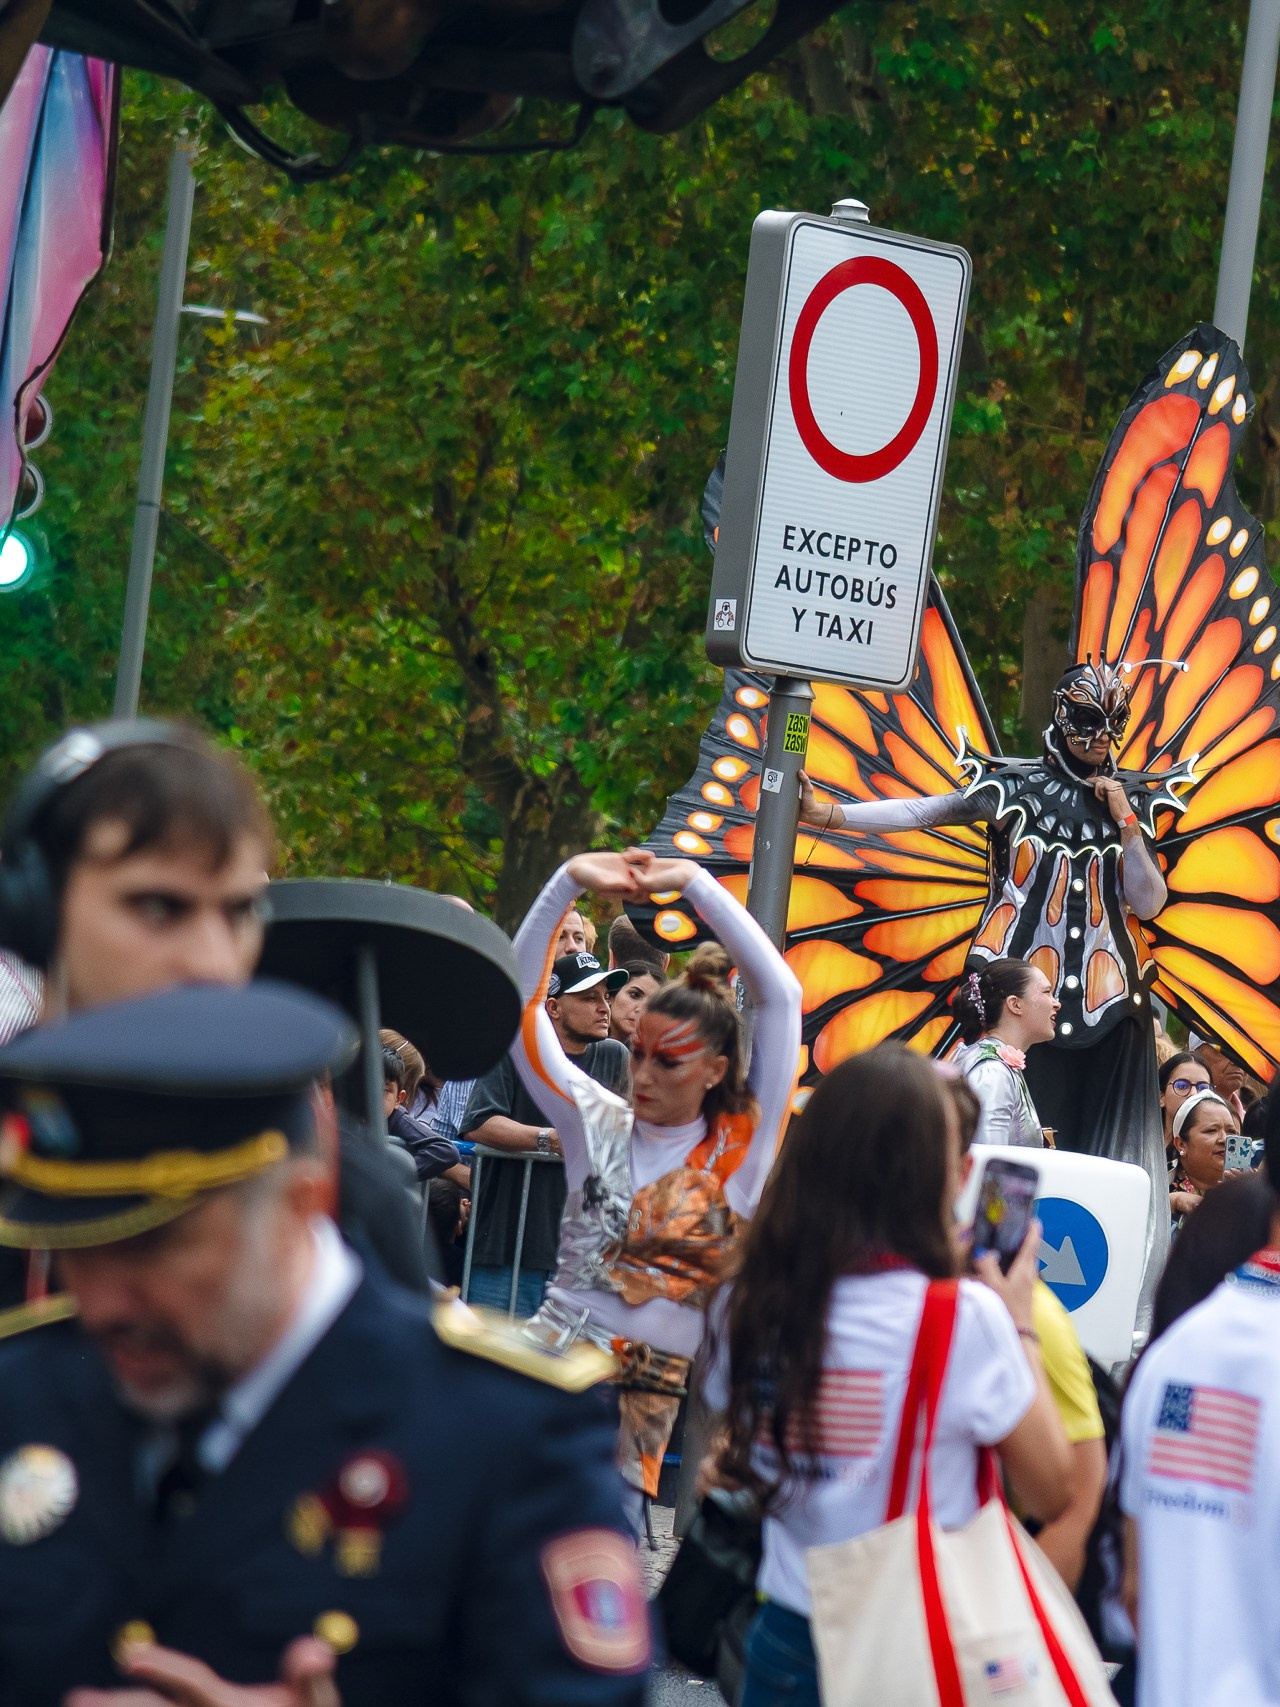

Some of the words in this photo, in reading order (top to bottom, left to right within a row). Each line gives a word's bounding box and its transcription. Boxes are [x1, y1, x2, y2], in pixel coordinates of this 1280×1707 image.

[783, 525, 897, 569] EXCEPTO
[774, 565, 897, 609] AUTOBÚS
[792, 607, 807, 632] Y
[815, 611, 873, 645] TAXI
